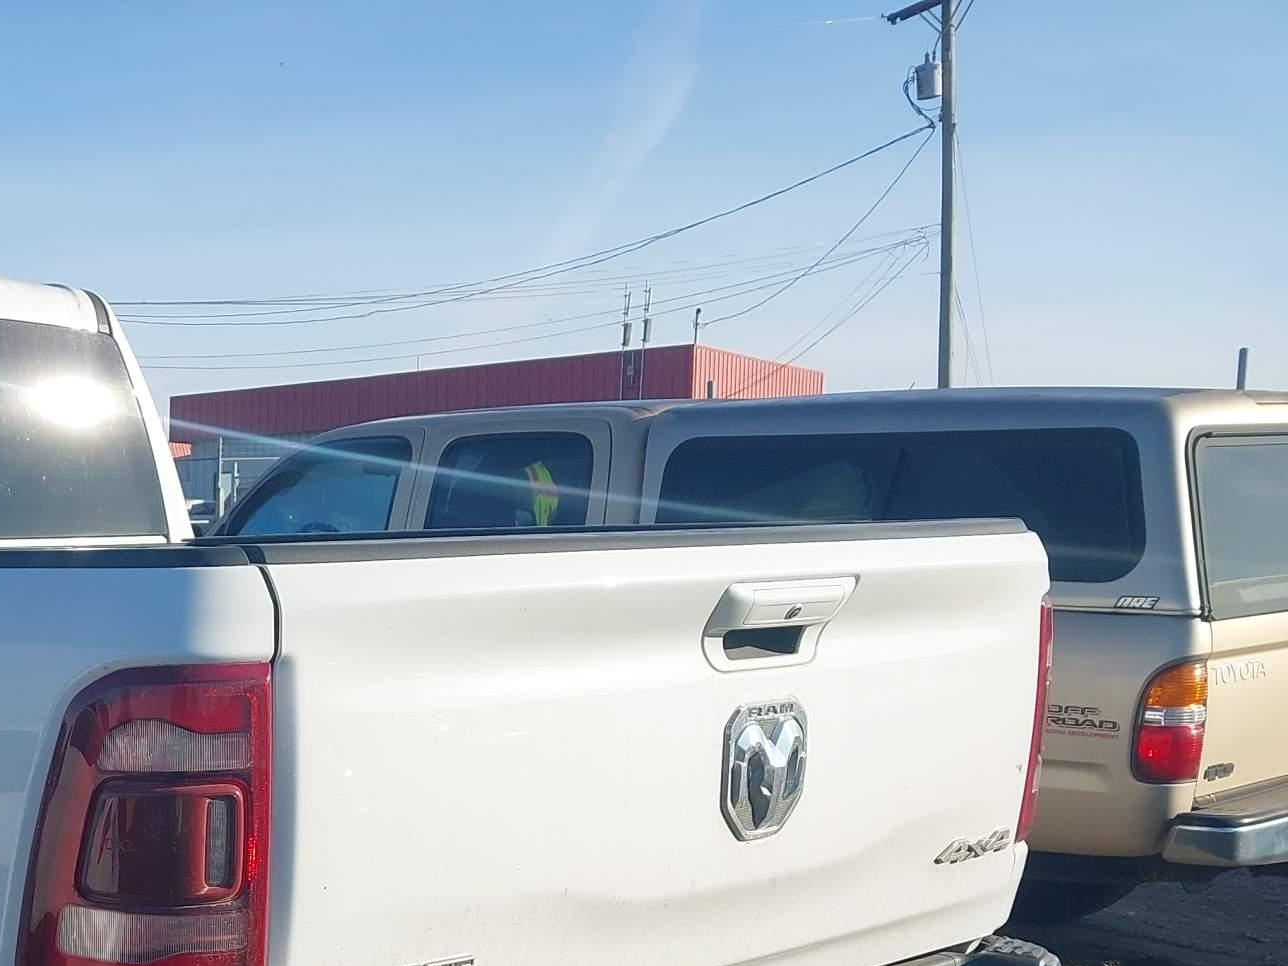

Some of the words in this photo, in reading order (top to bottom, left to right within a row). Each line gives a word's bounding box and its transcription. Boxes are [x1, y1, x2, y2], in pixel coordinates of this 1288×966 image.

[1211, 660, 1267, 685] TOYOTA
[747, 703, 794, 719] RAM
[1047, 716, 1120, 732] ROAD
